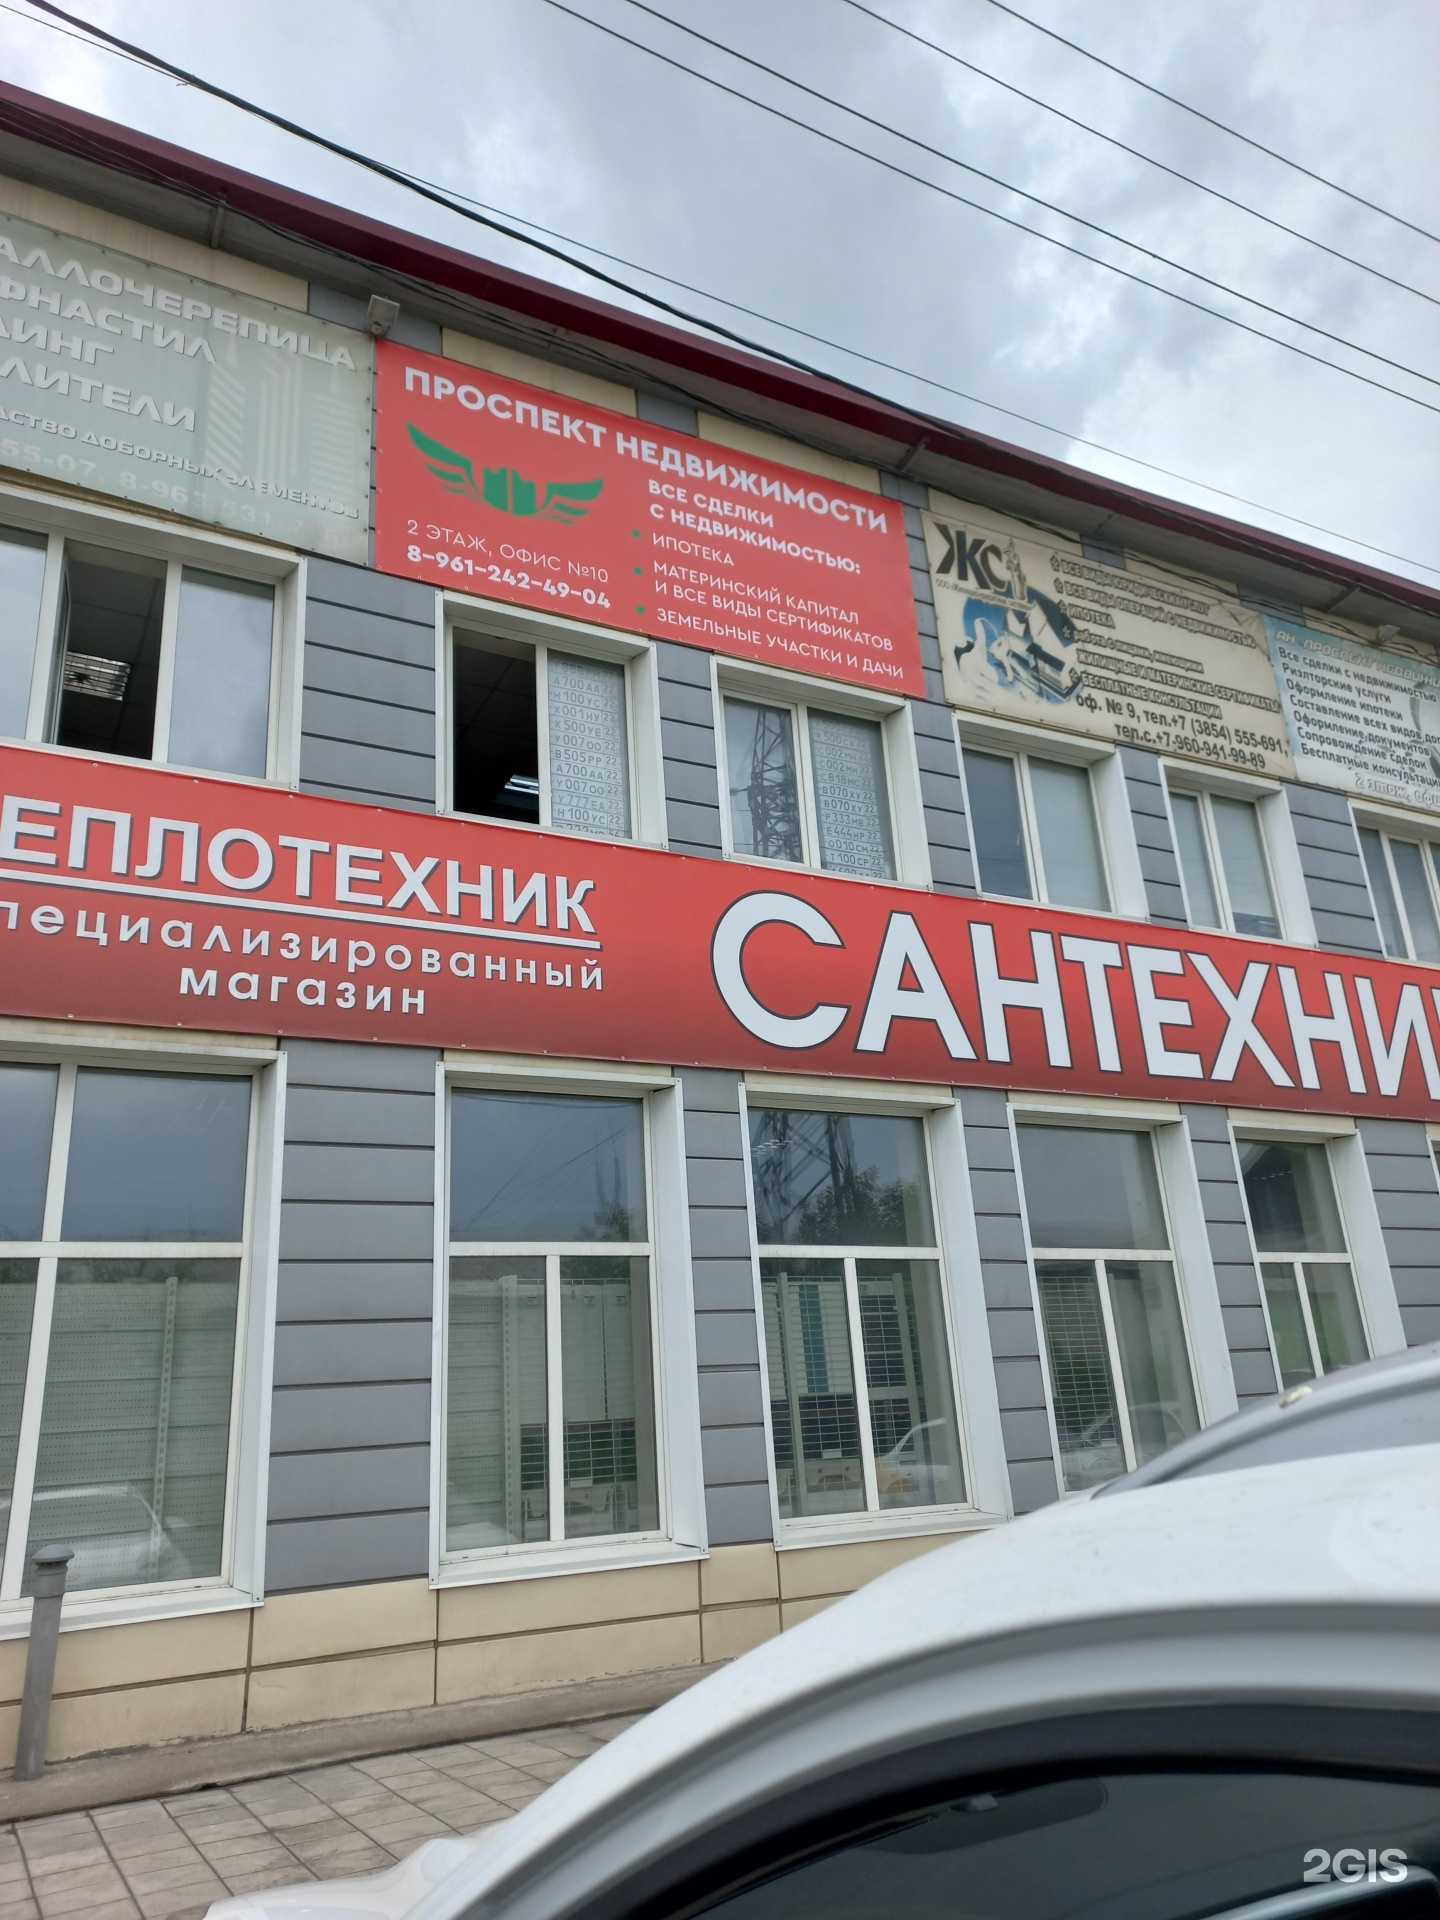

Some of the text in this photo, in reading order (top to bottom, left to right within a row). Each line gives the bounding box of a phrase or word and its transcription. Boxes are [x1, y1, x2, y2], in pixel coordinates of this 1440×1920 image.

[405, 366, 888, 534] ПРОСПЕКТ НЕДВИЖИМОСТИ
[649, 479, 774, 528] ВСЕ СДЕЛКИ
[407, 520, 608, 583] 2 ЭТАЖ, ОФИС №10
[650, 504, 861, 574] С НЕДВИЖИМОСТЬЮ:
[653, 533, 735, 566] ИПОТЕКА
[933, 521, 1007, 592] ЖКС
[407, 545, 611, 609] 8-961-242-49-04
[654, 560, 858, 625] МАТЕРИНСКИЙ КАПИТАЛ
[655, 580, 893, 651] И ВСЕ ВИДЫ СЕРТИФИКАТОВ
[1068, 603, 1116, 629] ИПОТЕКА
[657, 608, 903, 679] ЗЕМЕЛЬНЫЕ УЧАСТКИ И ДАЧИ
[1278, 647, 1299, 662] Все
[1303, 655, 1341, 674] сделки
[1345, 668, 1351, 678] с
[1080, 670, 1149, 702] БЕСПЛАТНЫЕ
[1282, 662, 1352, 693] Риэлторские
[1355, 685, 1392, 704] услуги
[1286, 678, 1403, 721] Оформление ипотеки
[1076, 693, 1102, 713] оф.
[1106, 697, 1123, 715] №
[1191, 716, 1232, 745] (3854)
[1290, 694, 1360, 723] Составление
[1364, 716, 1387, 730] всех
[1390, 723, 1422, 740] видов
[1294, 710, 1430, 757] Оформление документов
[1297, 726, 1427, 770] Сопровождение сделок
[1301, 743, 1369, 770] Бесплатные
[0, 795, 596, 934] ЕПЛОТЕХНИК
[180, 967, 426, 1016] магазин
[711, 889, 1440, 1101] САНТЕХНИ
